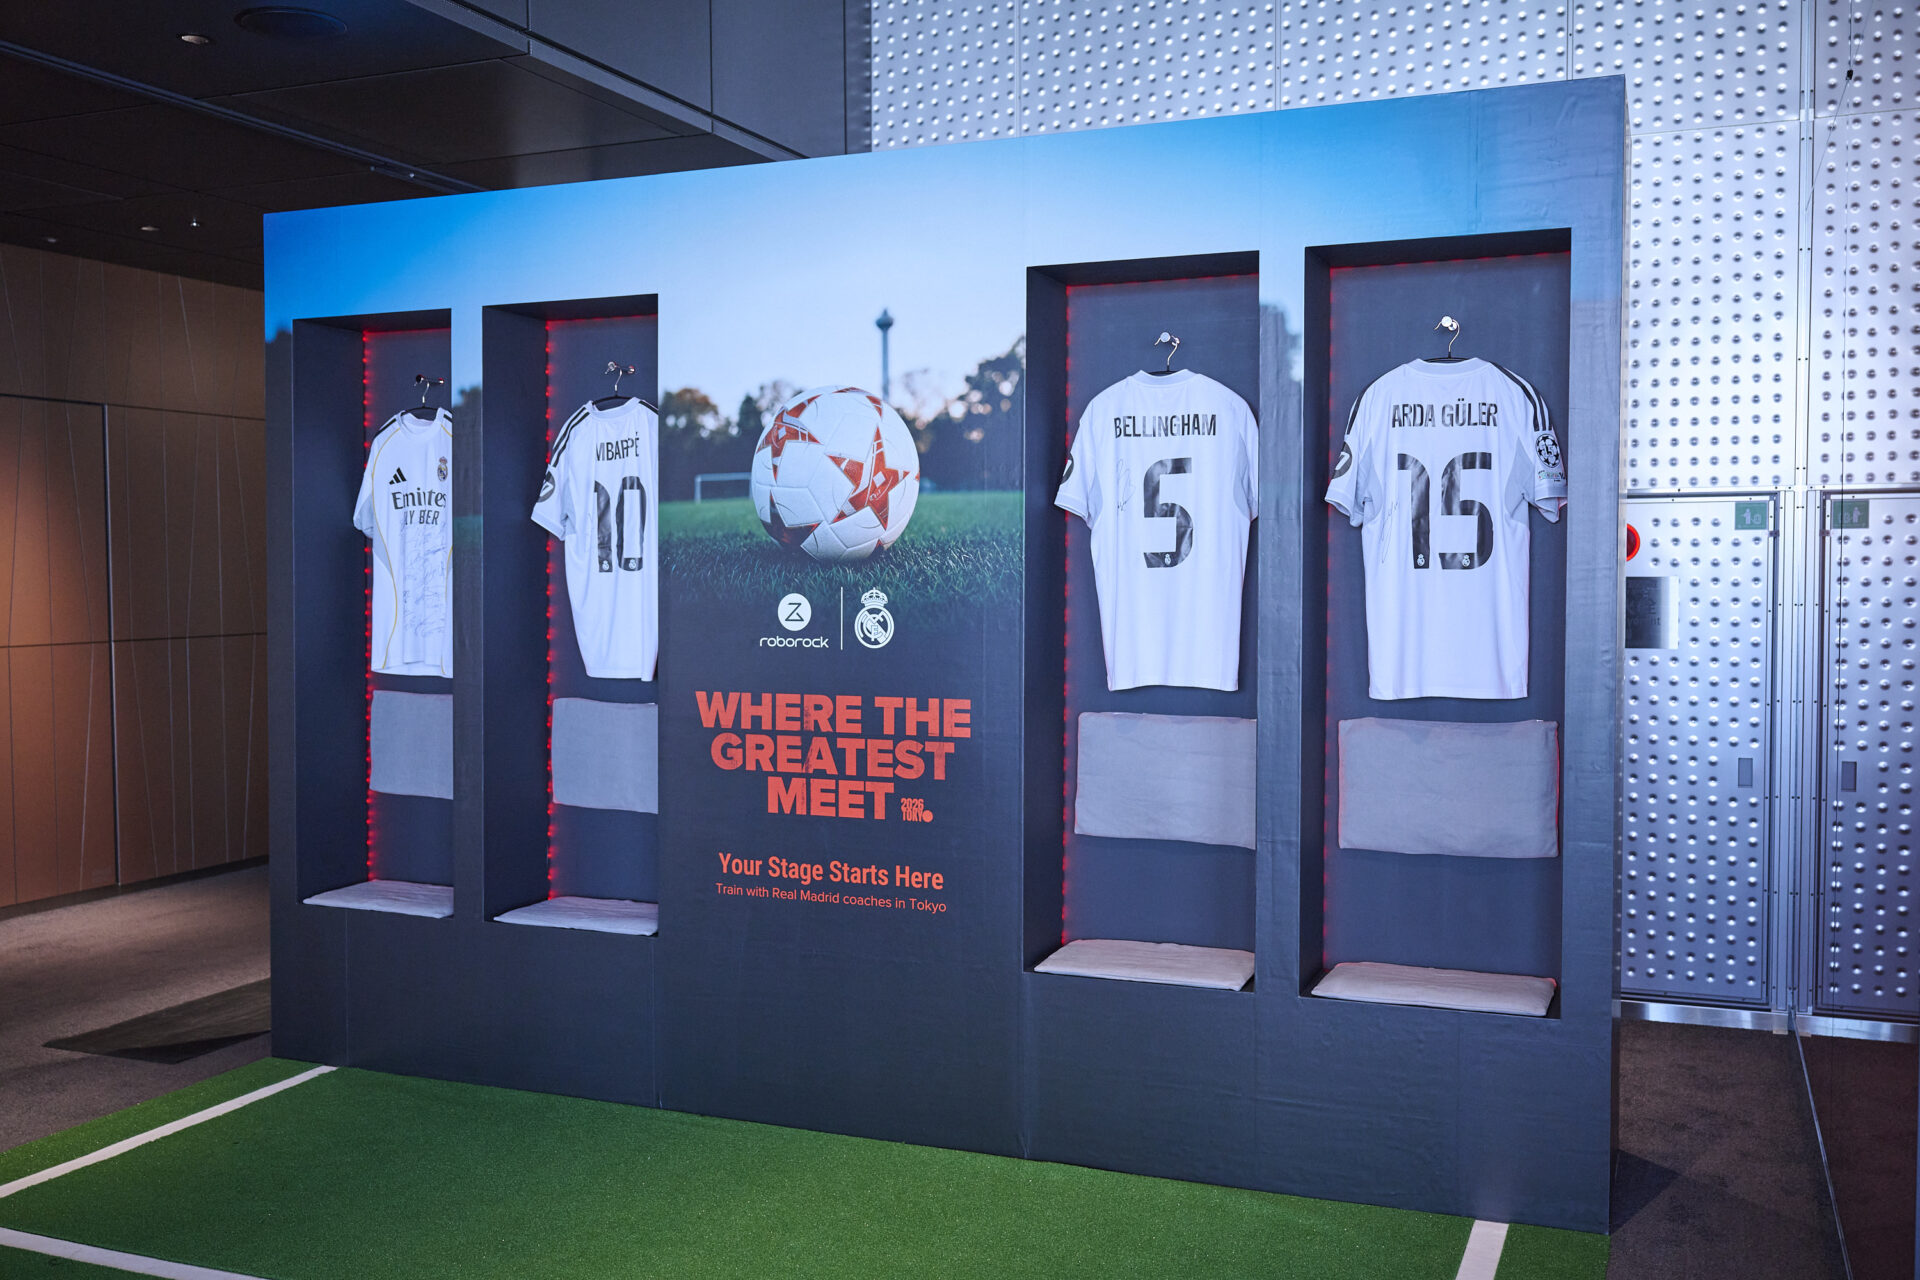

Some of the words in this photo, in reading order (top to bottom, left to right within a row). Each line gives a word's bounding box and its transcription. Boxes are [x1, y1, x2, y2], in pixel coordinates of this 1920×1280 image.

[1113, 413, 1217, 439] BELLINGHAM
[1391, 403, 1436, 428] ARDA
[1441, 398, 1498, 427] GÜLER
[593, 475, 647, 573] 10
[1143, 457, 1194, 569] 5
[1397, 451, 1494, 570] 15
[759, 635, 829, 648] roborock
[695, 690, 862, 734] WHERE
[874, 696, 971, 738] THE
[710, 732, 955, 781] GREATEST
[767, 776, 895, 820] MEET
[900, 797, 925, 810] 2026
[718, 852, 762, 876] Your
[768, 856, 823, 885] Stage
[829, 860, 889, 886] Starts
[895, 865, 944, 890] Here
[715, 882, 743, 896] Train
[746, 886, 769, 898] with
[772, 887, 797, 900] Real
[800, 889, 840, 903] Madrid
[843, 895, 892, 908] coaches
[895, 897, 906, 909] in
[909, 898, 947, 914] Tokyo
